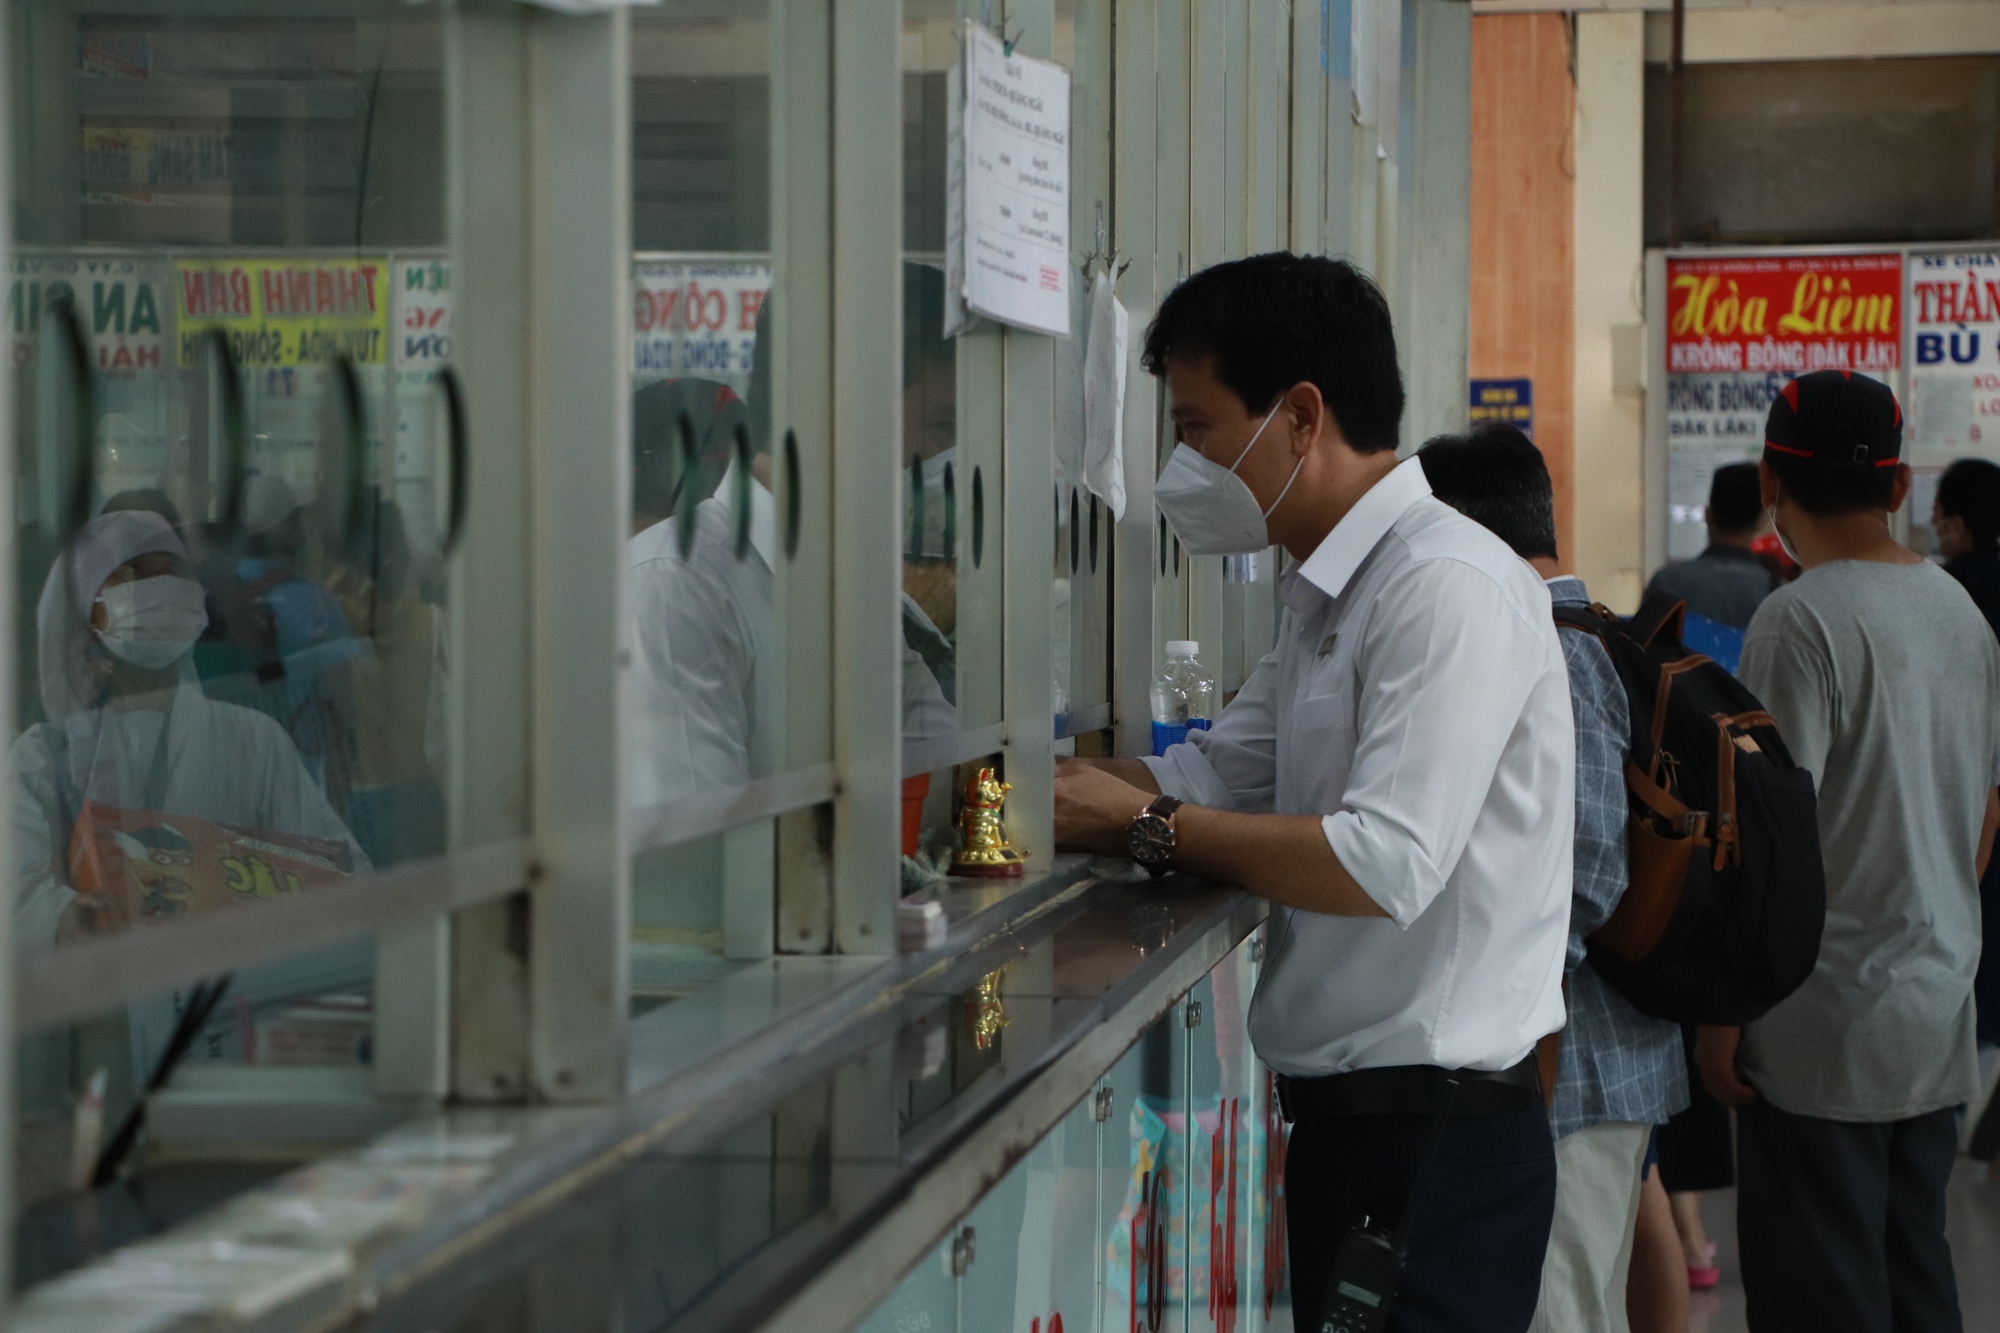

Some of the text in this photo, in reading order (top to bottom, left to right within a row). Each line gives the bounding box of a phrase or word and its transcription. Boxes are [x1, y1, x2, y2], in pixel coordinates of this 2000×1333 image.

[1671, 271, 1894, 336] Hòa Liêm
[1747, 334, 1804, 369] BÔNG
[1916, 322, 1981, 364] BÙ
